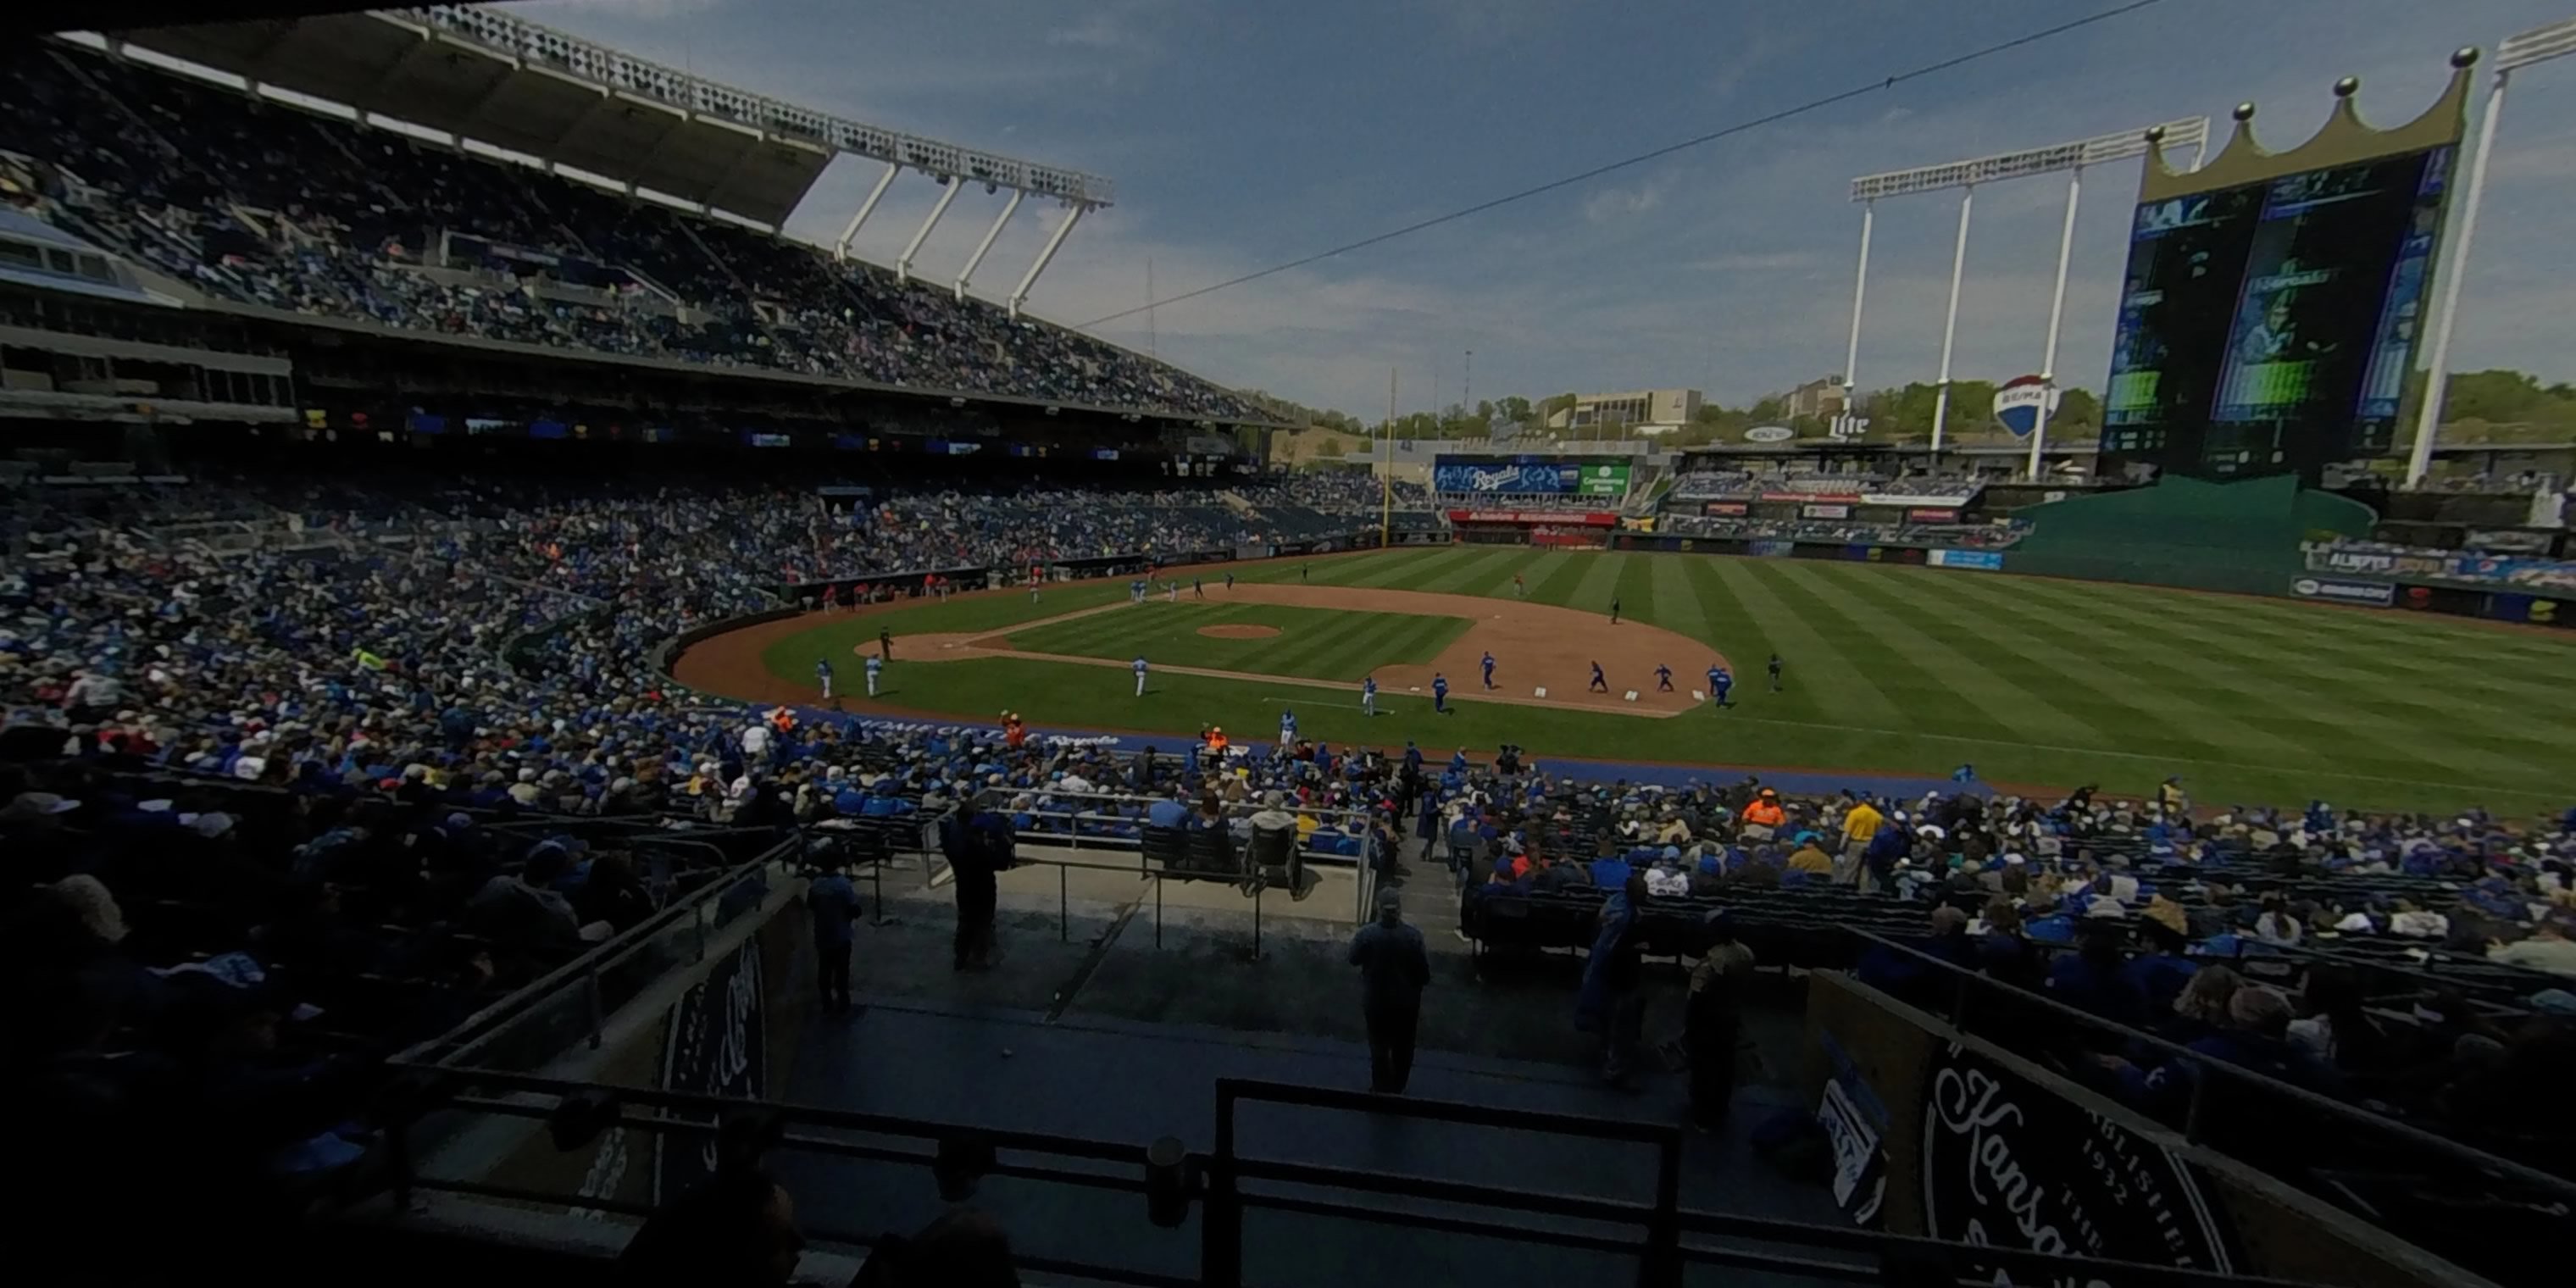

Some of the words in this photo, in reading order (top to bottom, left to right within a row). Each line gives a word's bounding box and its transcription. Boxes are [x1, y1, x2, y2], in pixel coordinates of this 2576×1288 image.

[2001, 391, 2043, 404] RE/MA
[1828, 415, 1870, 443] Lite
[1472, 464, 1520, 491] Royals
[1934, 1066, 2084, 1261] Kansa
[2082, 1138, 2129, 1207] 1932
[2061, 1181, 2103, 1257] THE
